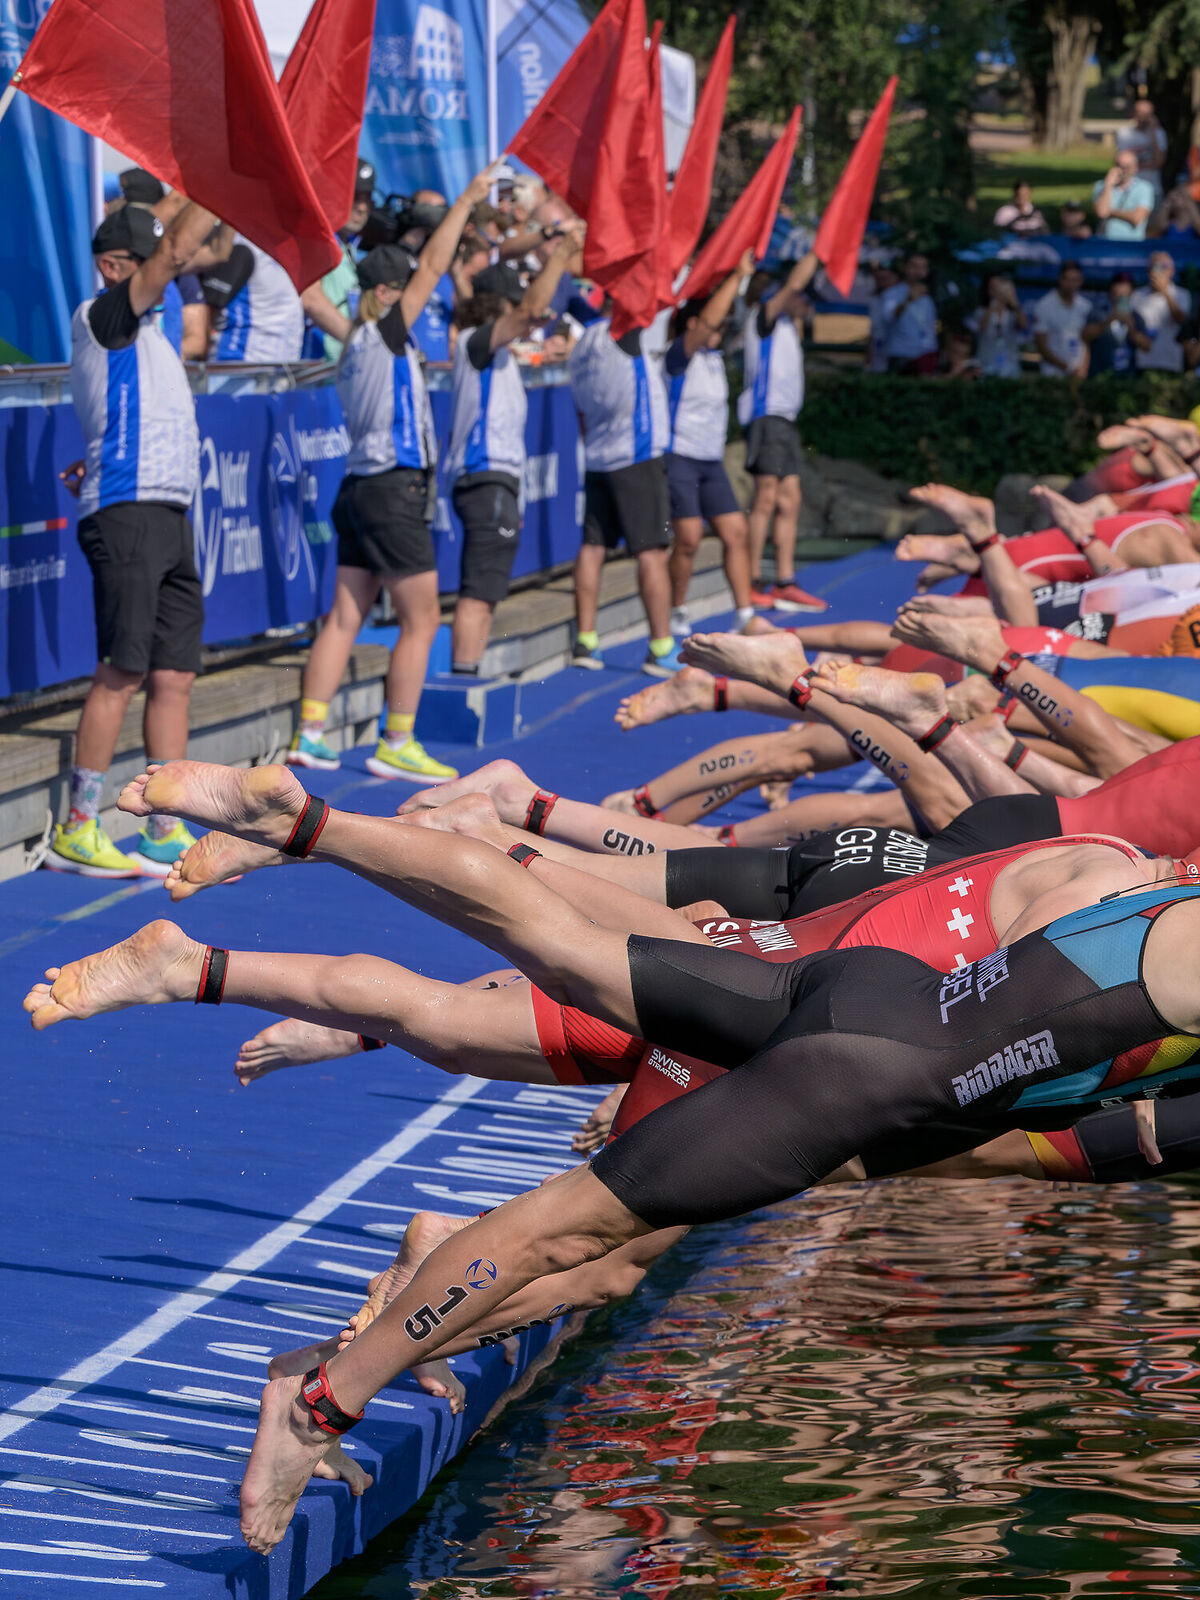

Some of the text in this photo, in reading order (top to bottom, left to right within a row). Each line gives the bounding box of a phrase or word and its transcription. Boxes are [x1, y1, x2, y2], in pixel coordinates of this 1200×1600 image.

[830, 828, 877, 873] GER
[651, 1048, 691, 1083] SWISS
[651, 1059, 688, 1089] TRIATHLON
[404, 1284, 470, 1343] 15
